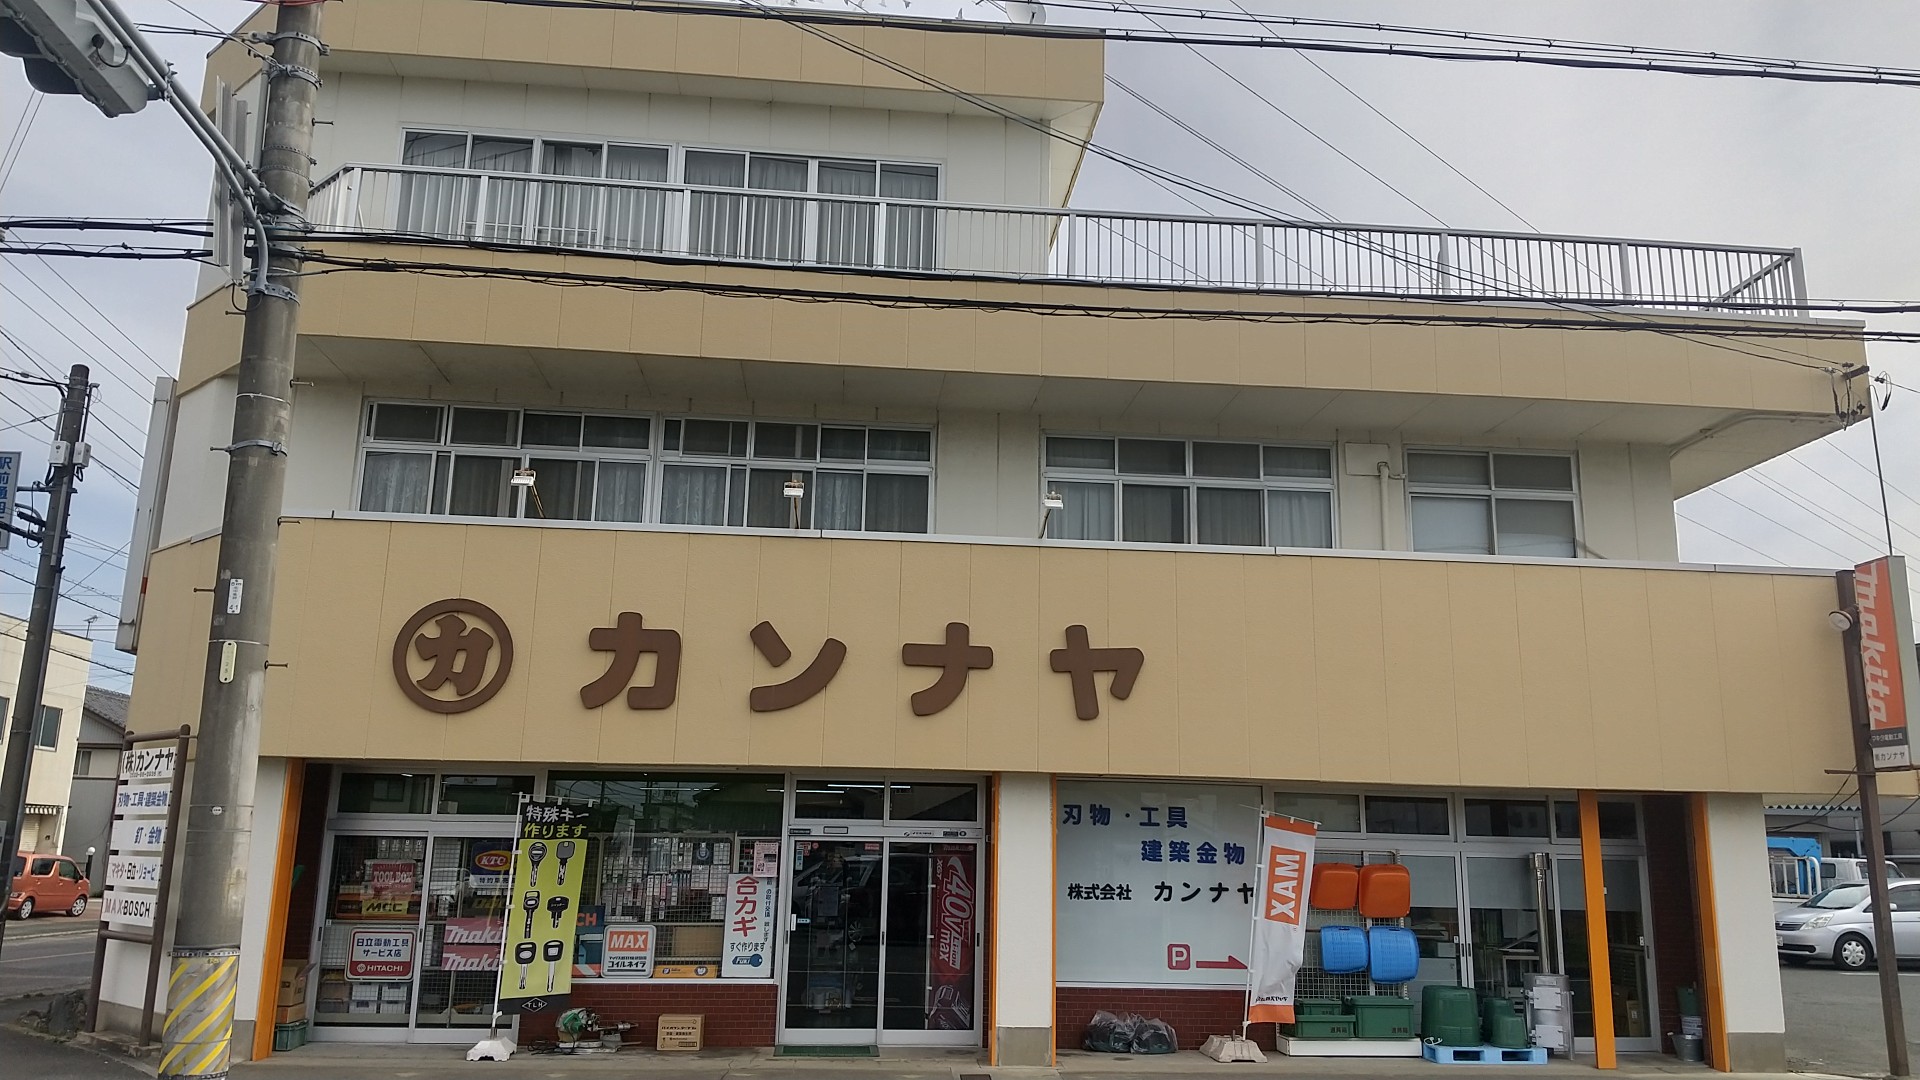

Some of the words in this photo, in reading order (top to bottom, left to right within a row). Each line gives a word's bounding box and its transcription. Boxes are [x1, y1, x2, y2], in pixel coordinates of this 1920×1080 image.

[580, 611, 1145, 720] カンナヤ
[525, 804, 590, 823] 特殊キー
[1062, 803, 1189, 829] 刃物・工具
[523, 822, 588, 838] 作ります
[1140, 839, 1246, 866] 建築金物
[480, 856, 508, 866] KTC
[373, 871, 395, 884] TOOL
[395, 871, 413, 883] BOX
[1067, 882, 1133, 902] 株式会社
[1153, 880, 1255, 905] カンナヤ
[732, 875, 760, 938] 合カギ
[356, 938, 410, 948] 日立電動工具
[610, 934, 647, 949] MAX
[729, 941, 766, 953] すぐ作ります
[363, 948, 402, 958] サービス店
[366, 964, 403, 972] HITACHI
[607, 960, 647, 968] コイルネイラ
